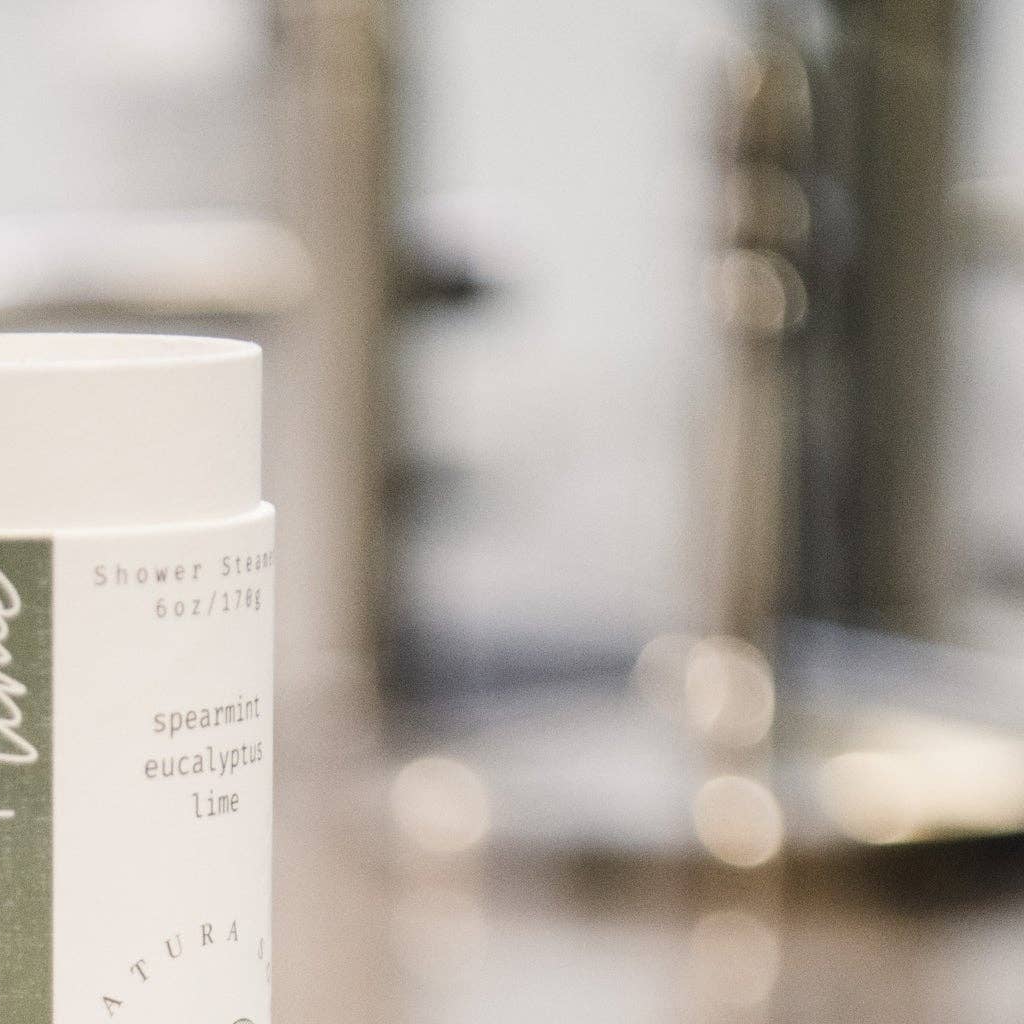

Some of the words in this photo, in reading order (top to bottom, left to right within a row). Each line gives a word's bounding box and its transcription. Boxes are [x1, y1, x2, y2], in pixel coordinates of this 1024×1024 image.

[93, 562, 203, 587] Shower
[152, 696, 260, 738] spearmint
[144, 741, 263, 779] eucalyptus
[191, 789, 240, 819] lime
